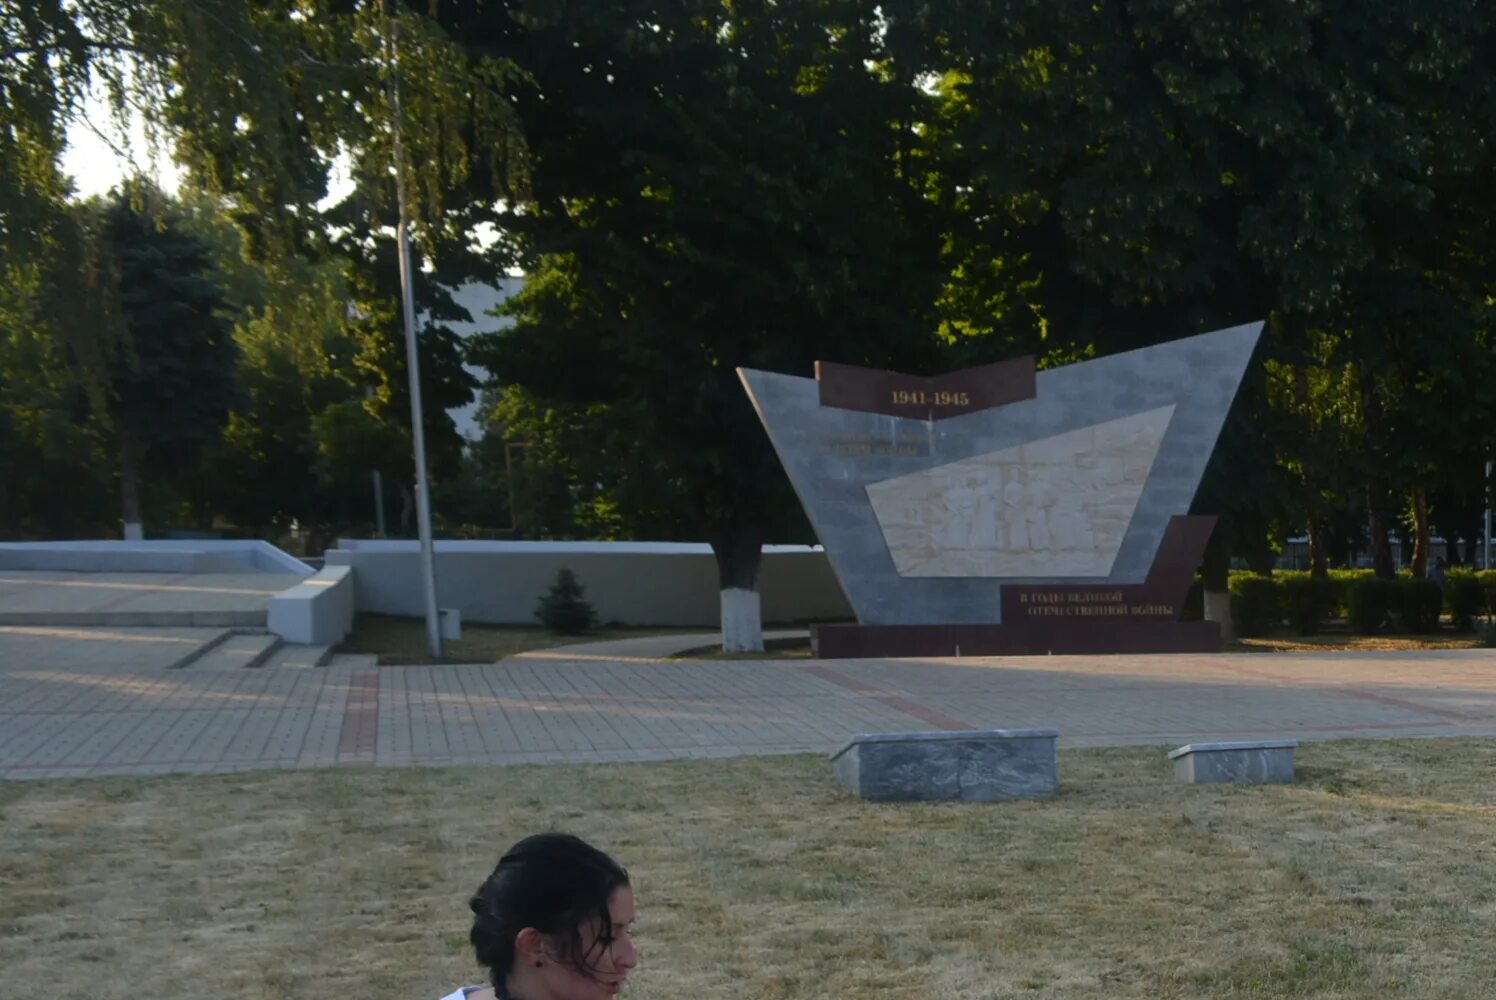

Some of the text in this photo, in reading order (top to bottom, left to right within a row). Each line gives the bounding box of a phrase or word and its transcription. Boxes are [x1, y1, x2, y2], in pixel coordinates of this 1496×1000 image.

[891, 391, 970, 406] 1941-1945
[1020, 591, 1123, 603] В ГОДЫ ВЕЛИКОЙ
[1028, 604, 1174, 616] ОТЕЧЕСТВЕННОЙ ВОЙНЫ
